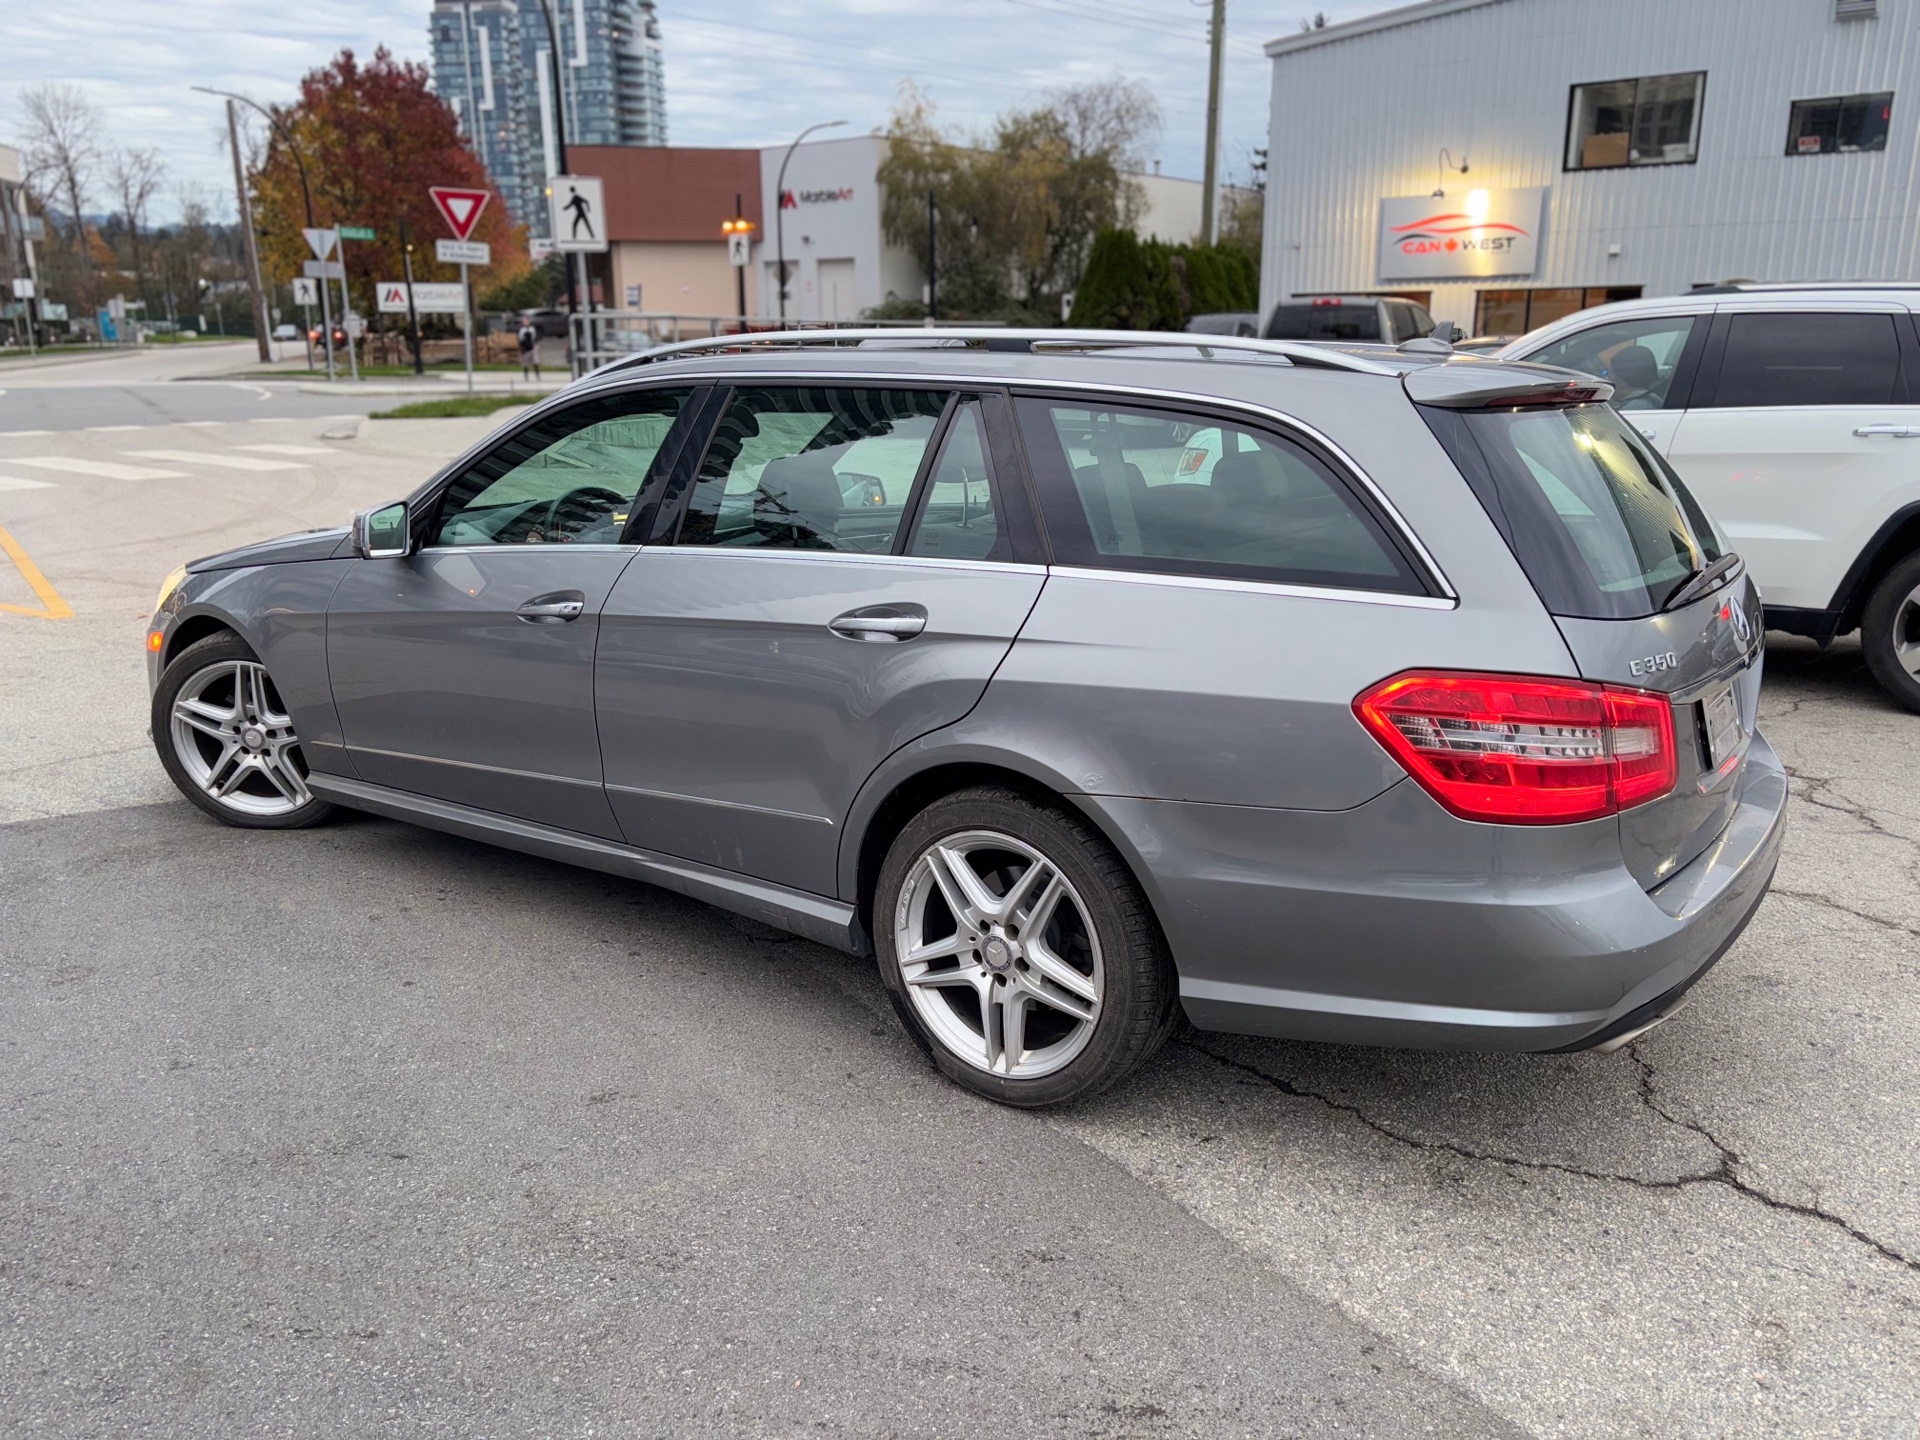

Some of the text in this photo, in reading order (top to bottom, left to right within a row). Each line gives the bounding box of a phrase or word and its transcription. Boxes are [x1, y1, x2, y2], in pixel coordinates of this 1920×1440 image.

[799, 187, 853, 203] MarbleArt
[1402, 237, 1516, 255] CAN WEST
[1629, 652, 1677, 677] E 350
